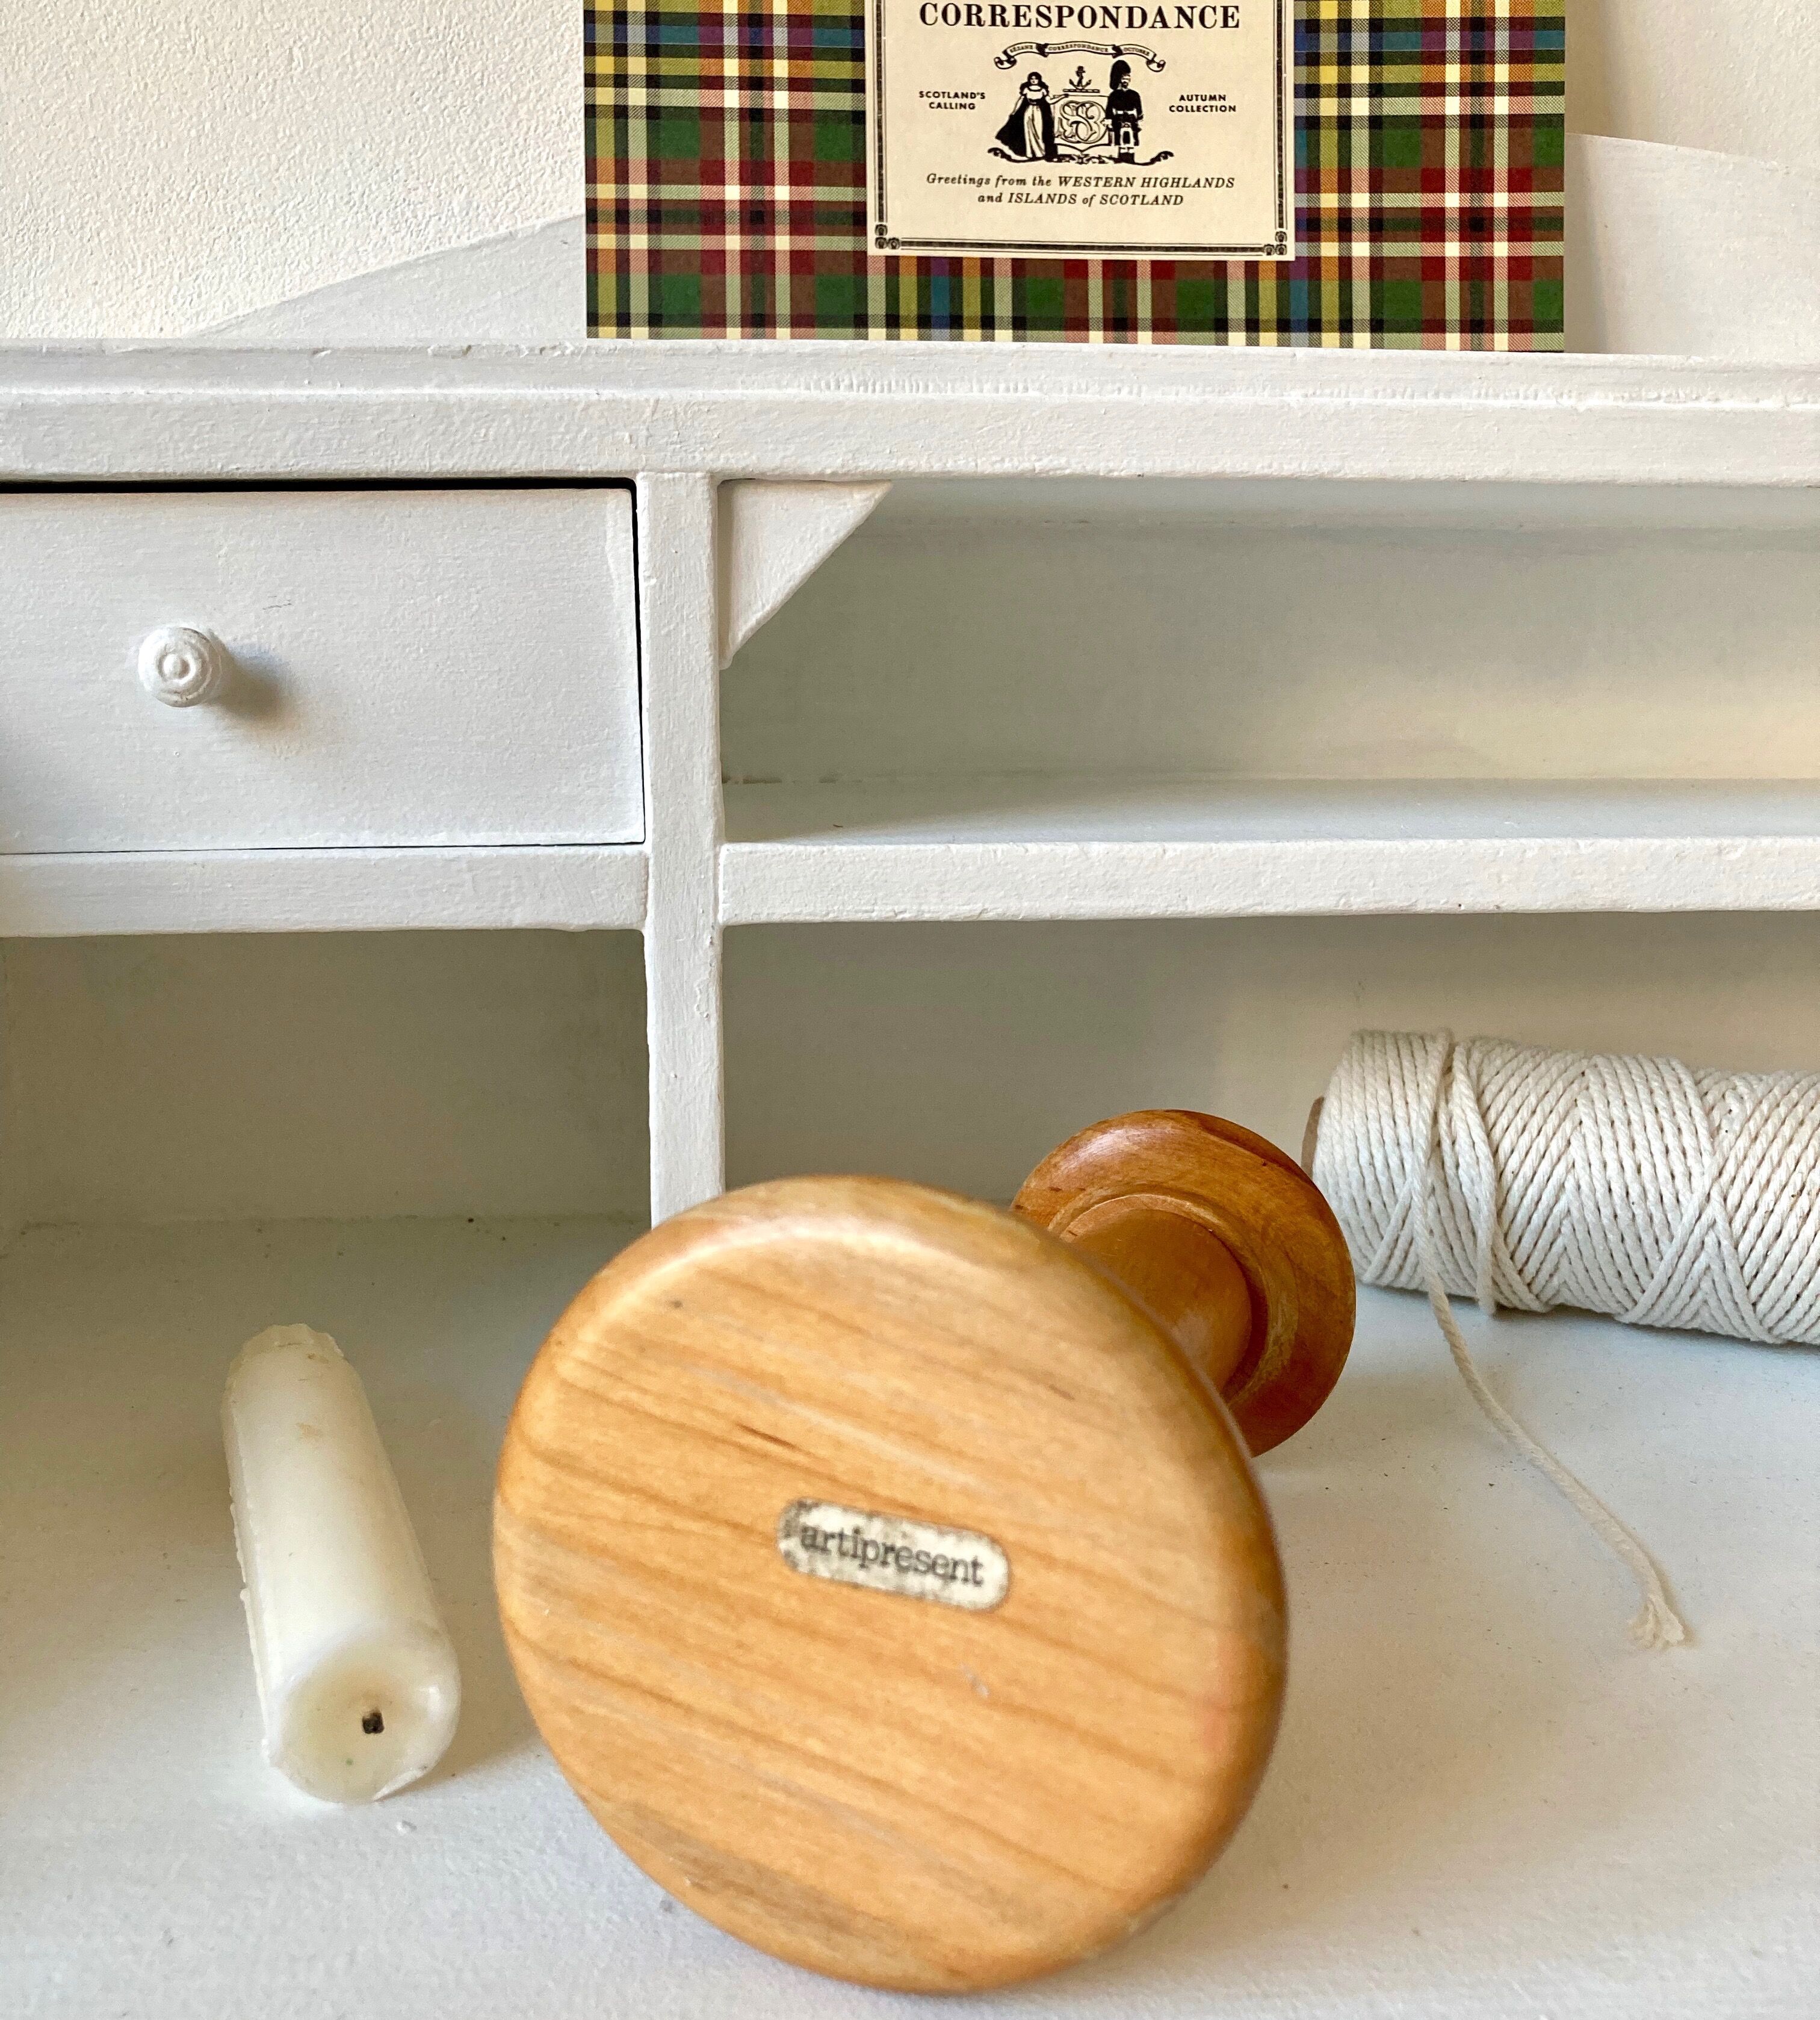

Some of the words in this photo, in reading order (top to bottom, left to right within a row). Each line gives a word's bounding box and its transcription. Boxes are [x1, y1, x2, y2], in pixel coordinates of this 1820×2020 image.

[920, 2, 1240, 28] CORRESPONDANCE
[918, 91, 985, 99] SCOTLAND'S
[926, 173, 991, 188] Greetings
[994, 175, 1027, 188] from
[1032, 176, 1052, 187] the
[1058, 176, 1136, 187] WESTERN
[1141, 177, 1235, 188] HIGHLANDS
[977, 193, 1003, 203] and
[1008, 193, 1077, 204] ISLANDS
[1082, 194, 1096, 208] of
[1100, 194, 1183, 205] SCOTLAND
[800, 1524, 983, 1587] artipresent
